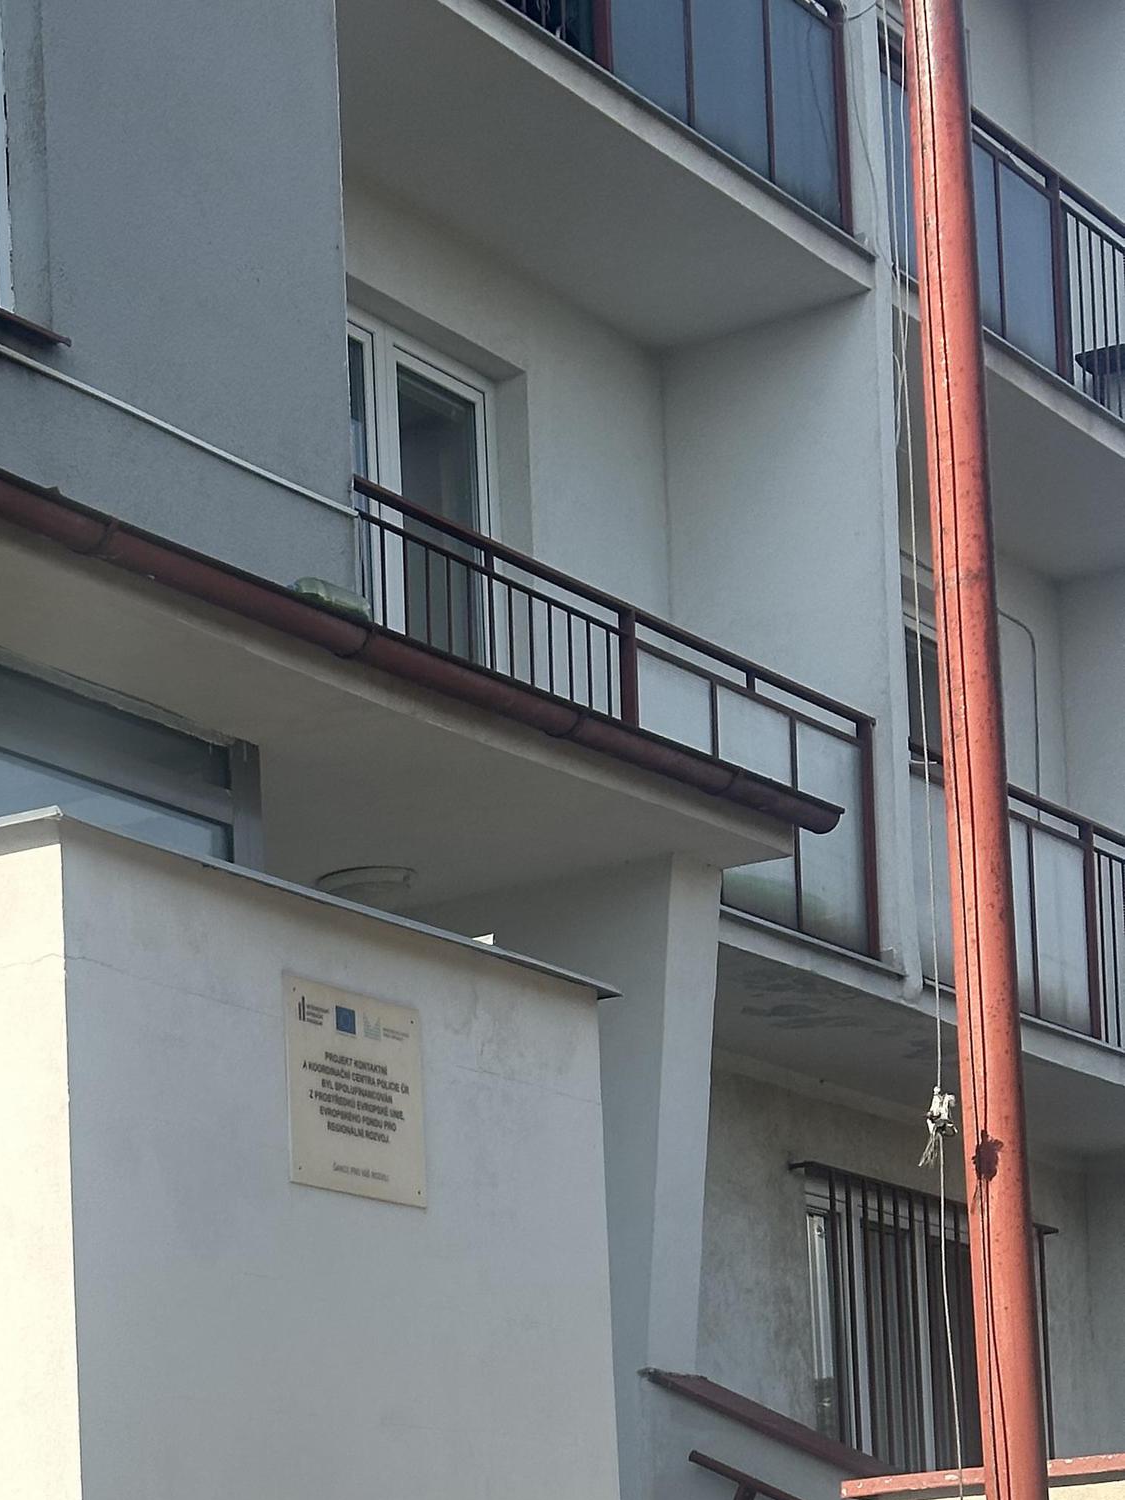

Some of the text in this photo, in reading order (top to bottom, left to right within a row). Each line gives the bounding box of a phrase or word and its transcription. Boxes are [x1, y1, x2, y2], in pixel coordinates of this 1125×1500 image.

[324, 1051, 353, 1066] PROJEKT
[321, 1078, 334, 1090] BYL
[351, 1072, 376, 1085] CENTRA
[376, 1078, 400, 1093] POLICIE
[383, 1120, 397, 1132] PRO
